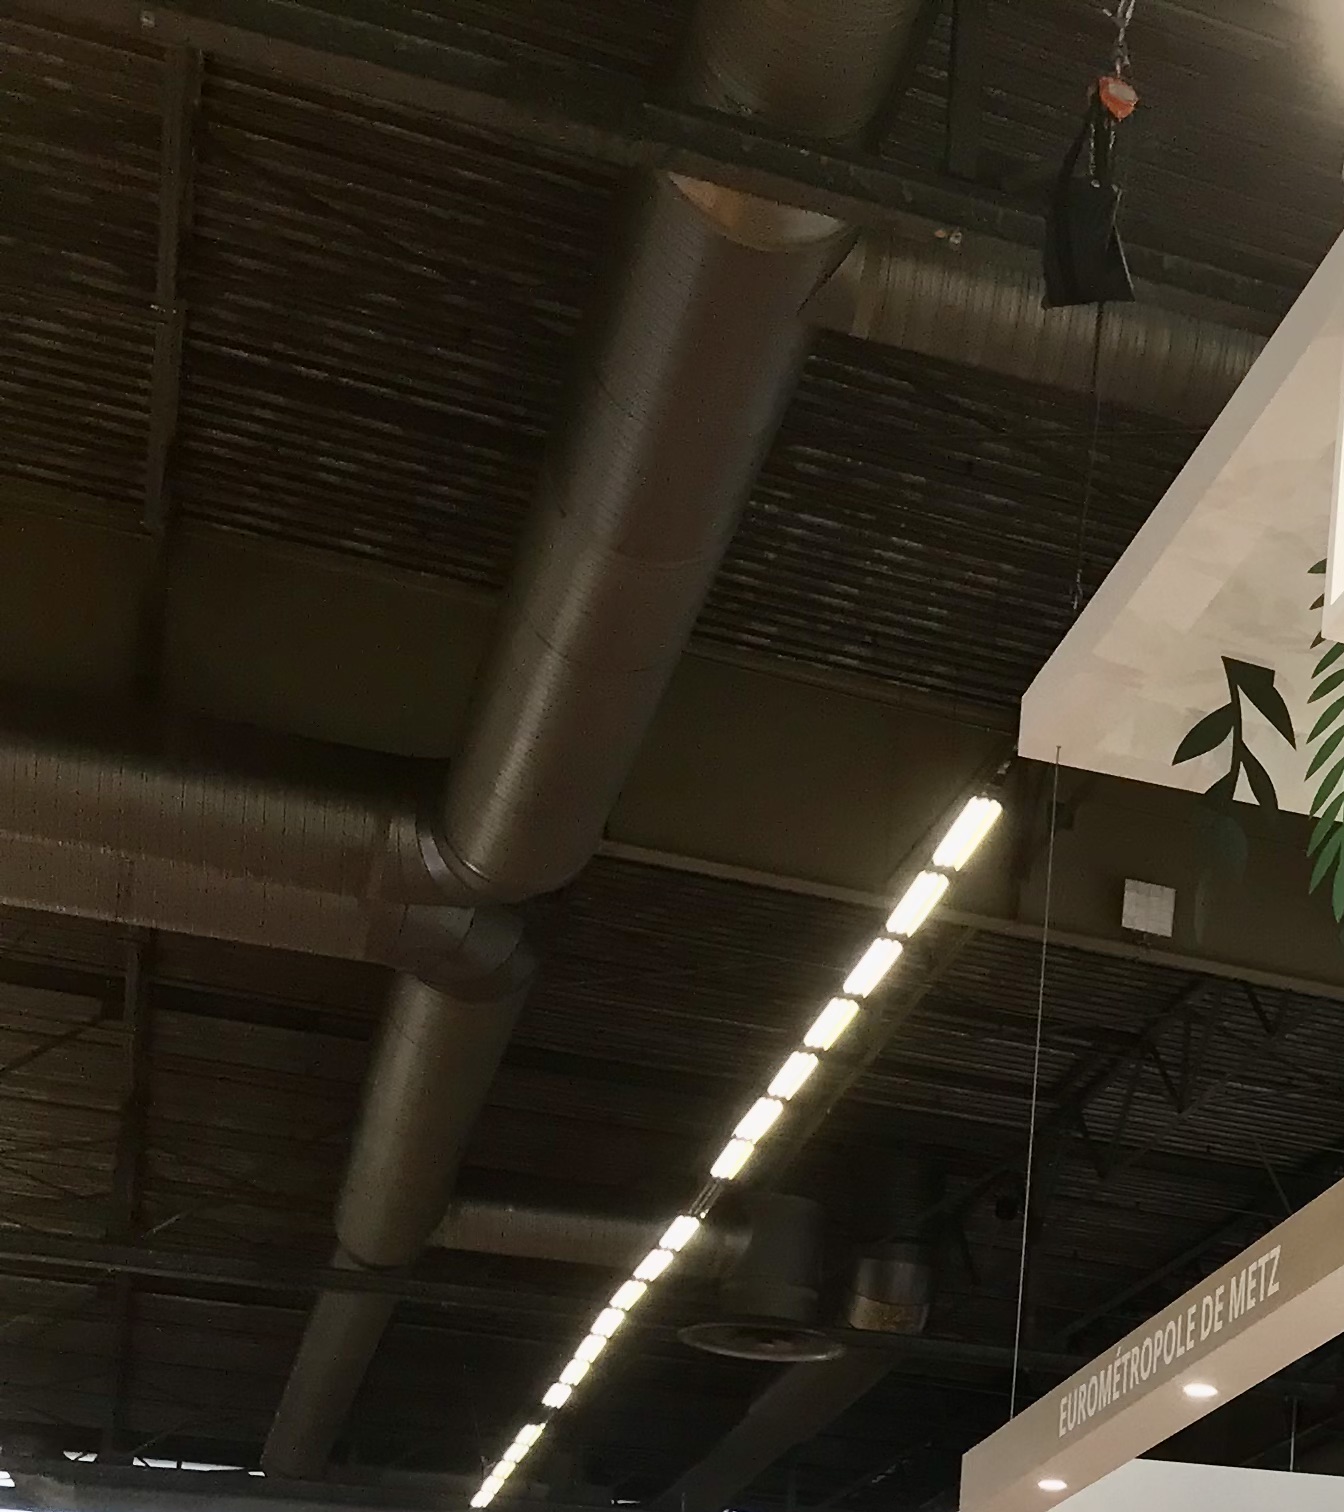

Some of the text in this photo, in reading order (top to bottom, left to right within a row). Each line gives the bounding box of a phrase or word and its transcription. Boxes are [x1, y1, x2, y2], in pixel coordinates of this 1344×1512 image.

[1058, 1244, 1282, 1438] EUROMÉTROPOLE DE METZ
